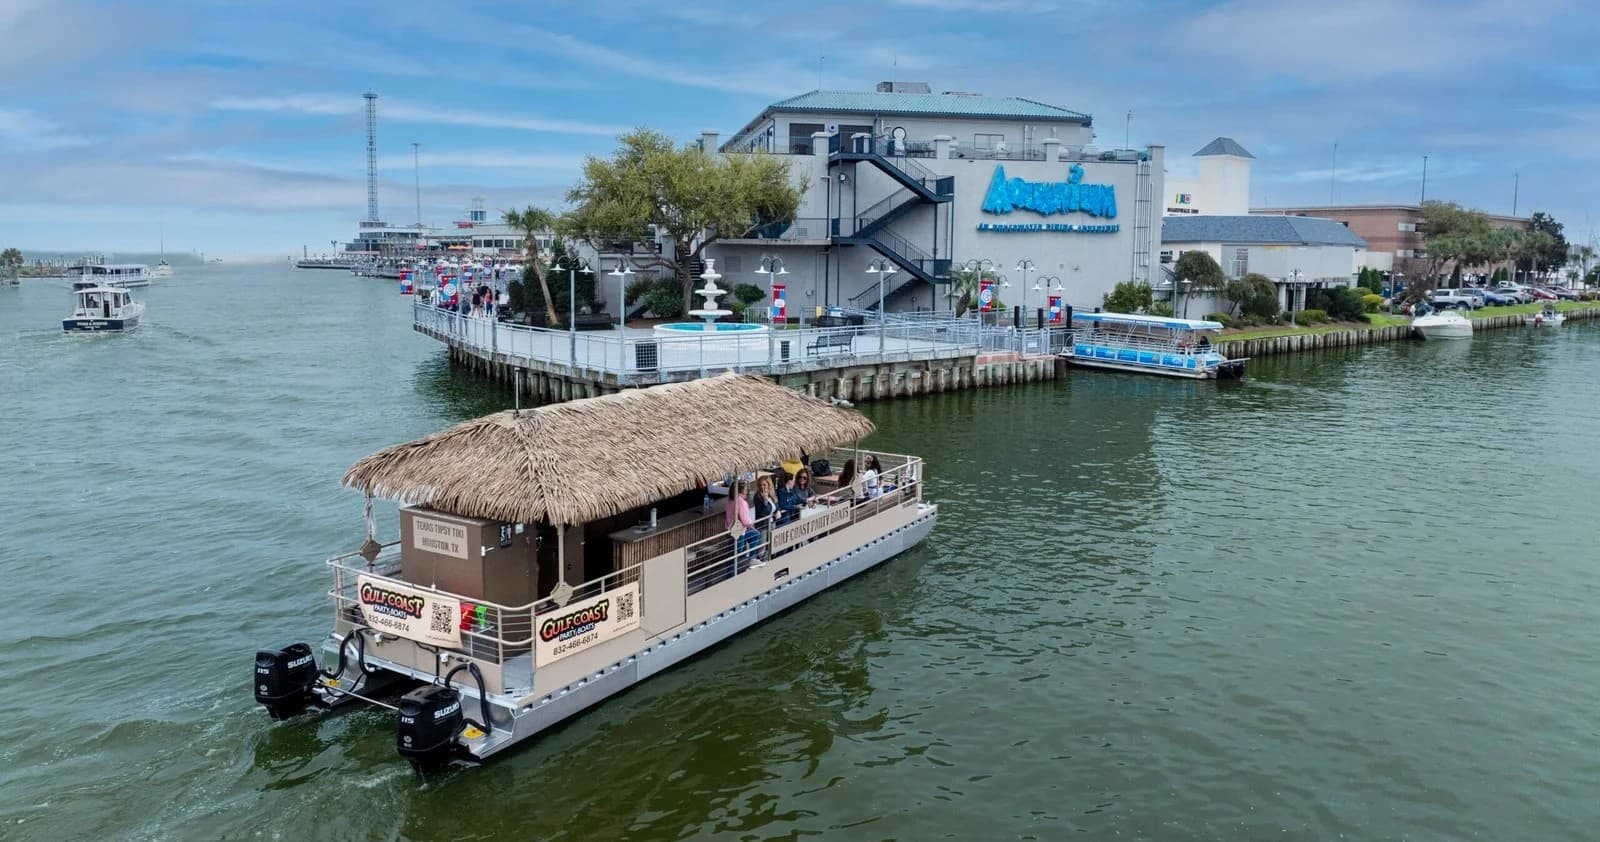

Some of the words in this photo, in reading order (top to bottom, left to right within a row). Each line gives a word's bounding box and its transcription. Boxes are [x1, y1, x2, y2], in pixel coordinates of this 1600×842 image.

[416, 520, 434, 533] TEXAS
[773, 530, 790, 548] GULF
[790, 521, 810, 540] COAST
[810, 513, 830, 533] PARTY
[830, 506, 849, 523] BOATS
[451, 543, 460, 553] TX
[374, 604, 389, 614] PARTY
[389, 608, 407, 619] BOATS
[559, 630, 577, 641] PARTY
[577, 622, 595, 635] BOATS
[553, 632, 598, 655] 832-466-6874
[287, 654, 313, 669] SUZUKI
[257, 667, 270, 675] 115
[433, 701, 460, 719] SUZUKI
[401, 716, 415, 724] 115
